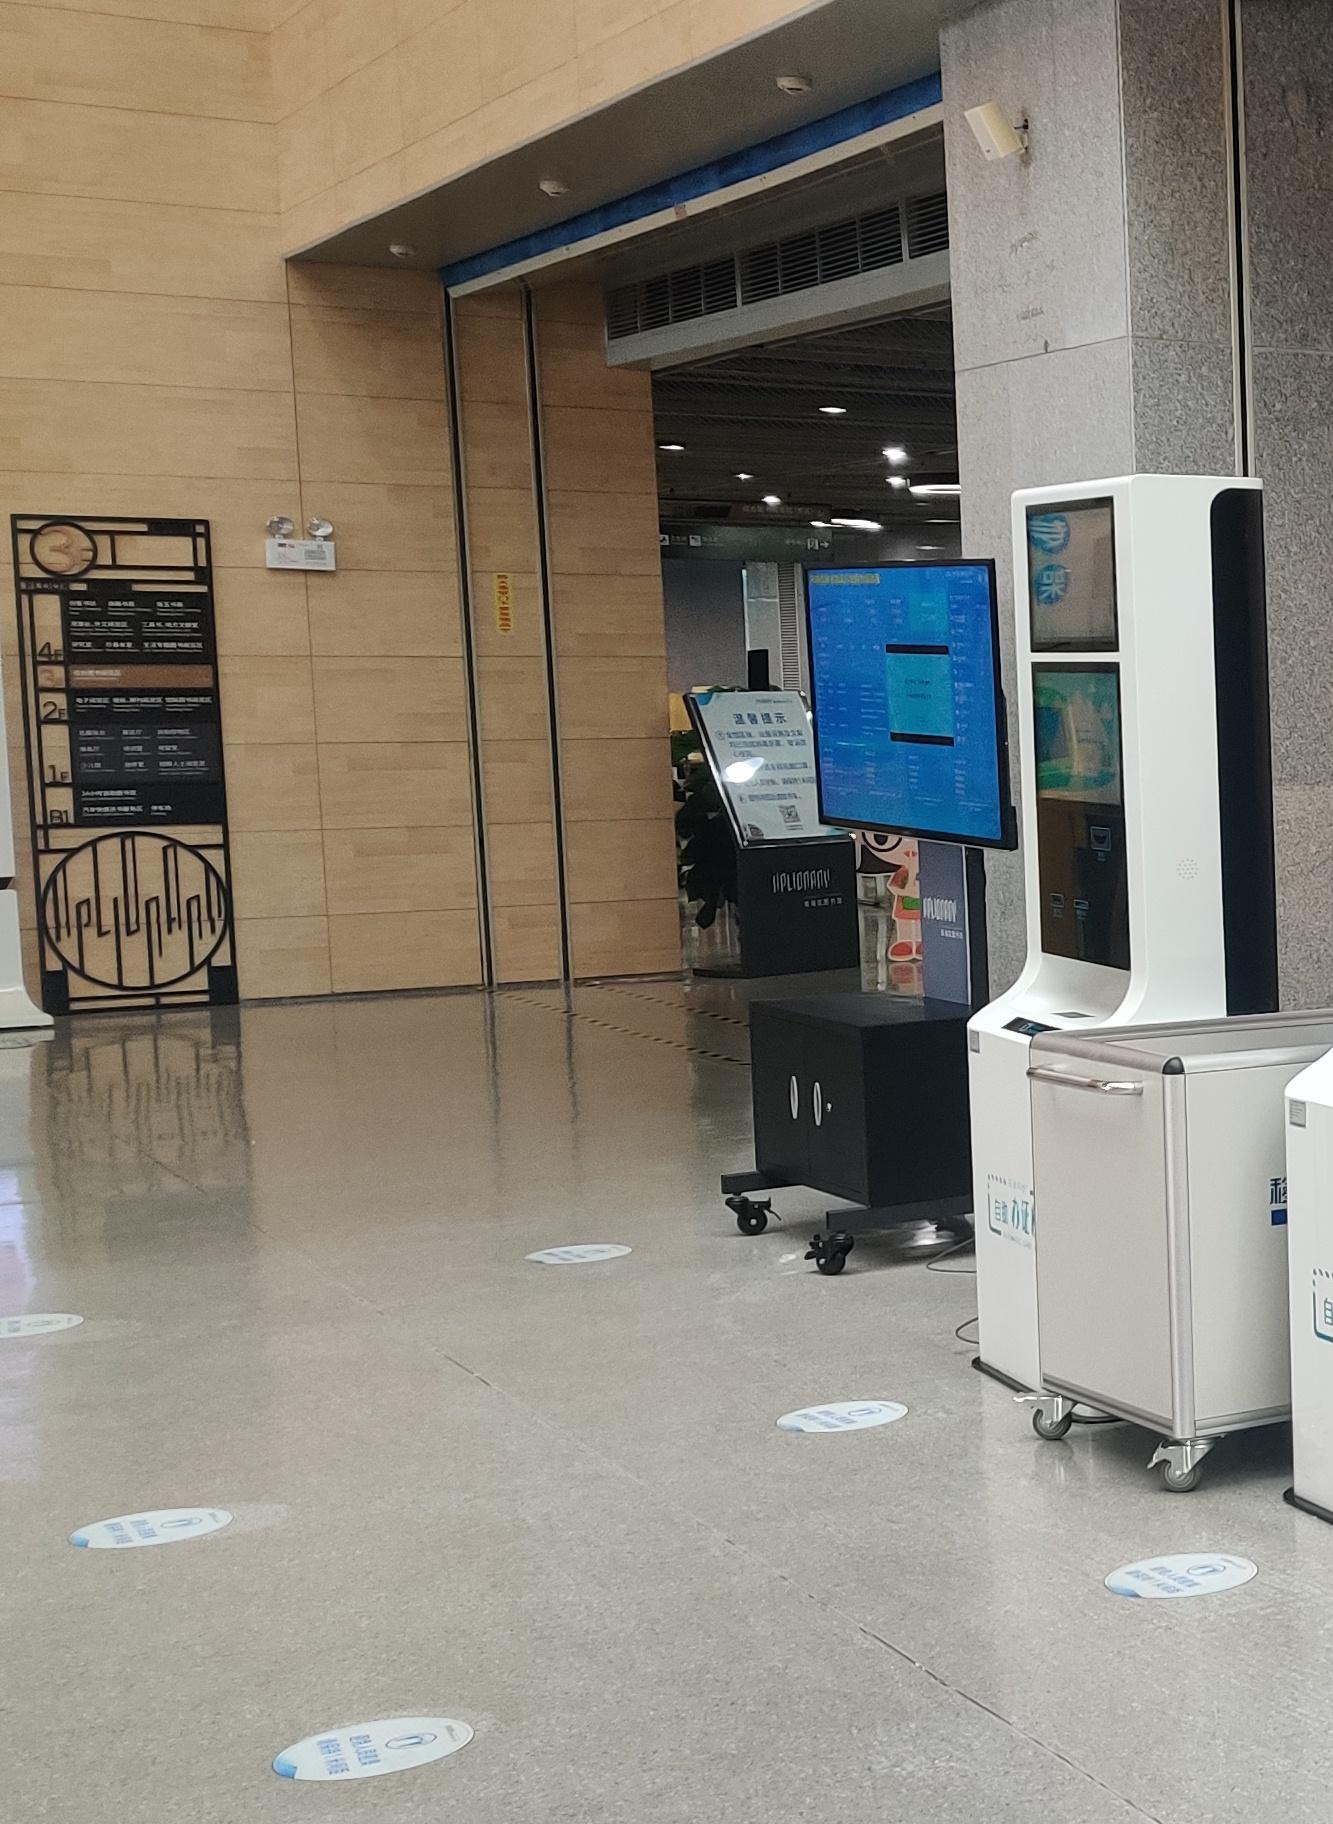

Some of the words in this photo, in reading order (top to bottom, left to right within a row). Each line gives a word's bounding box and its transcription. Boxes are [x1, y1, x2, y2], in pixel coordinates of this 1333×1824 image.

[732, 712, 787, 725] 温馨提示
[995, 1198, 1034, 1236] 自助办证
